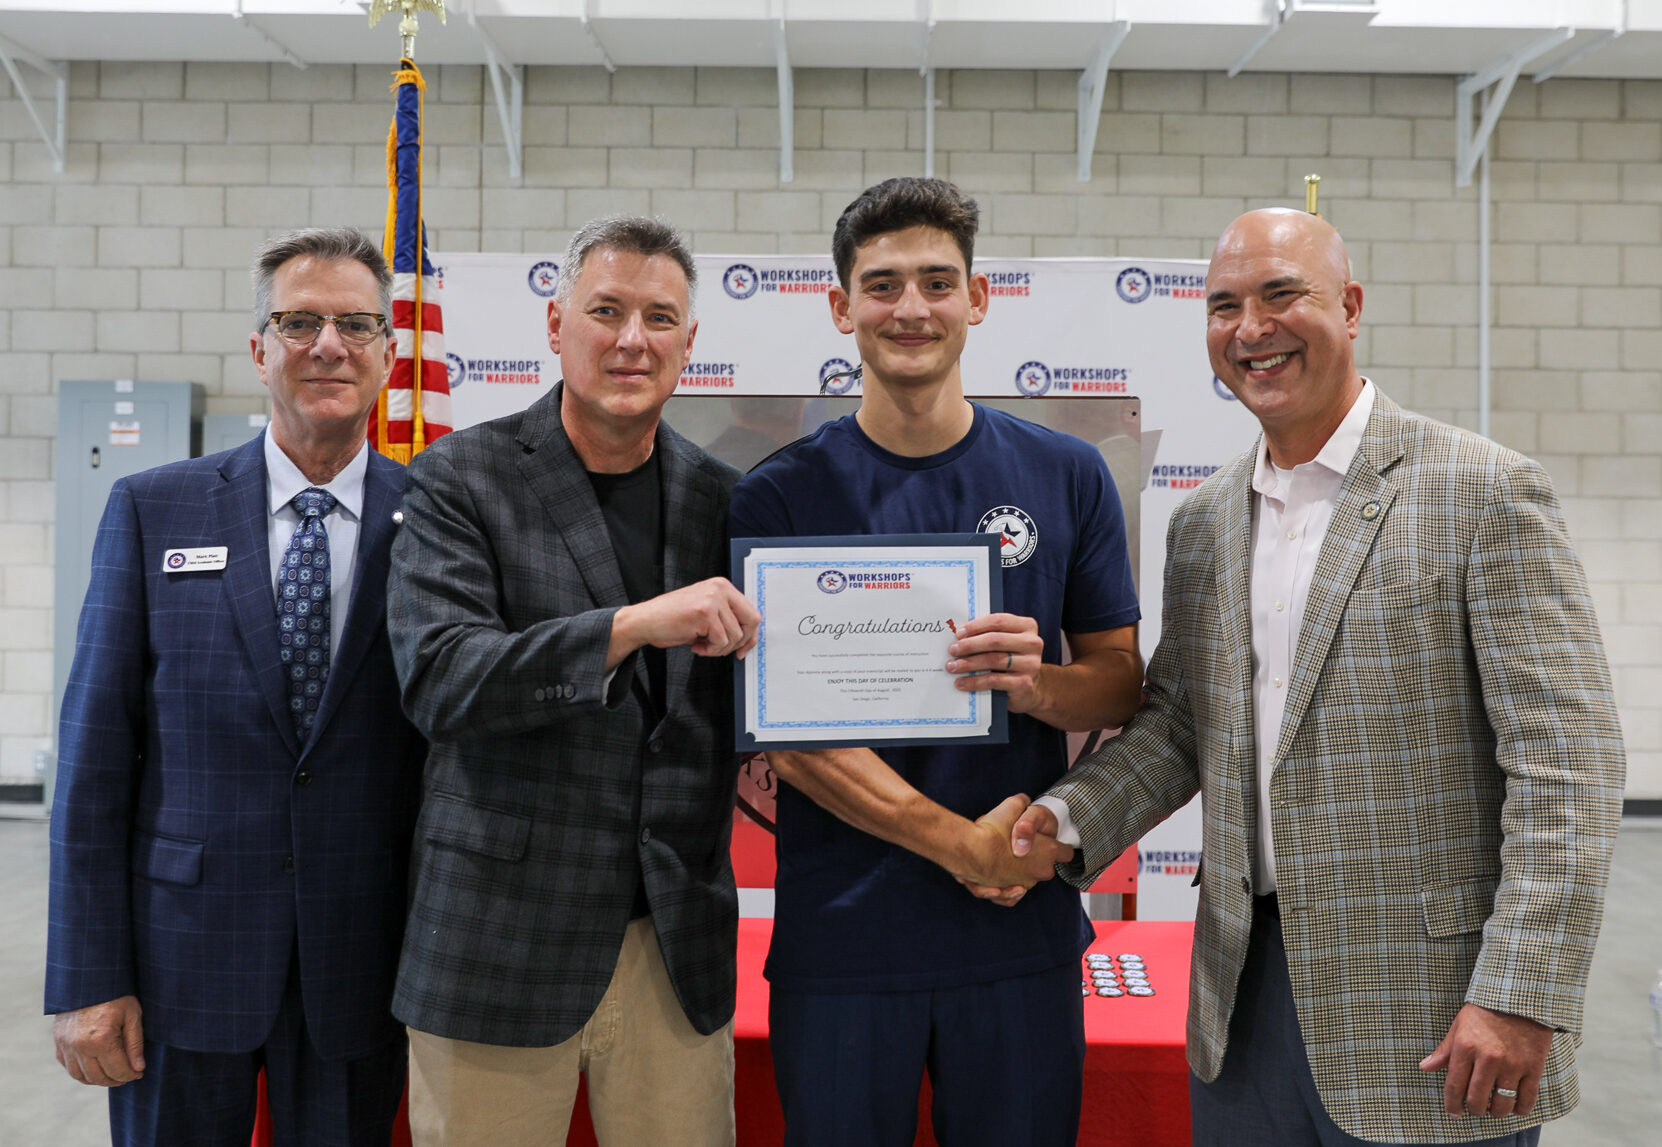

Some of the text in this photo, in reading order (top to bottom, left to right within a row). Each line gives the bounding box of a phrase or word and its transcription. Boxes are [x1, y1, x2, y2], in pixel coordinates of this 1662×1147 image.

[761, 270, 833, 281] WORKSHOPS
[987, 273, 1030, 285] SHOPS
[1154, 275, 1207, 287] WORKSH
[761, 284, 777, 292] FOR
[991, 286, 1030, 297] RRIORS
[1155, 288, 1170, 296] FOR
[468, 360, 540, 372] WORKSHOPS
[683, 363, 735, 375] KSHOPS
[486, 374, 540, 384] WARRIORS
[1053, 368, 1127, 380] WORKSHOPS
[680, 376, 735, 387] WARRIORS
[1054, 382, 1127, 392] FOR WARRIORS
[1152, 465, 1224, 477] WORKSHOP
[1152, 479, 1203, 489] FOR WARR
[1005, 557, 1018, 565] FOR
[849, 573, 911, 582] WORKSHOPS
[865, 582, 911, 590] WARRIORS
[798, 615, 945, 641] Congratulations
[1146, 851, 1202, 862] WORKSH
